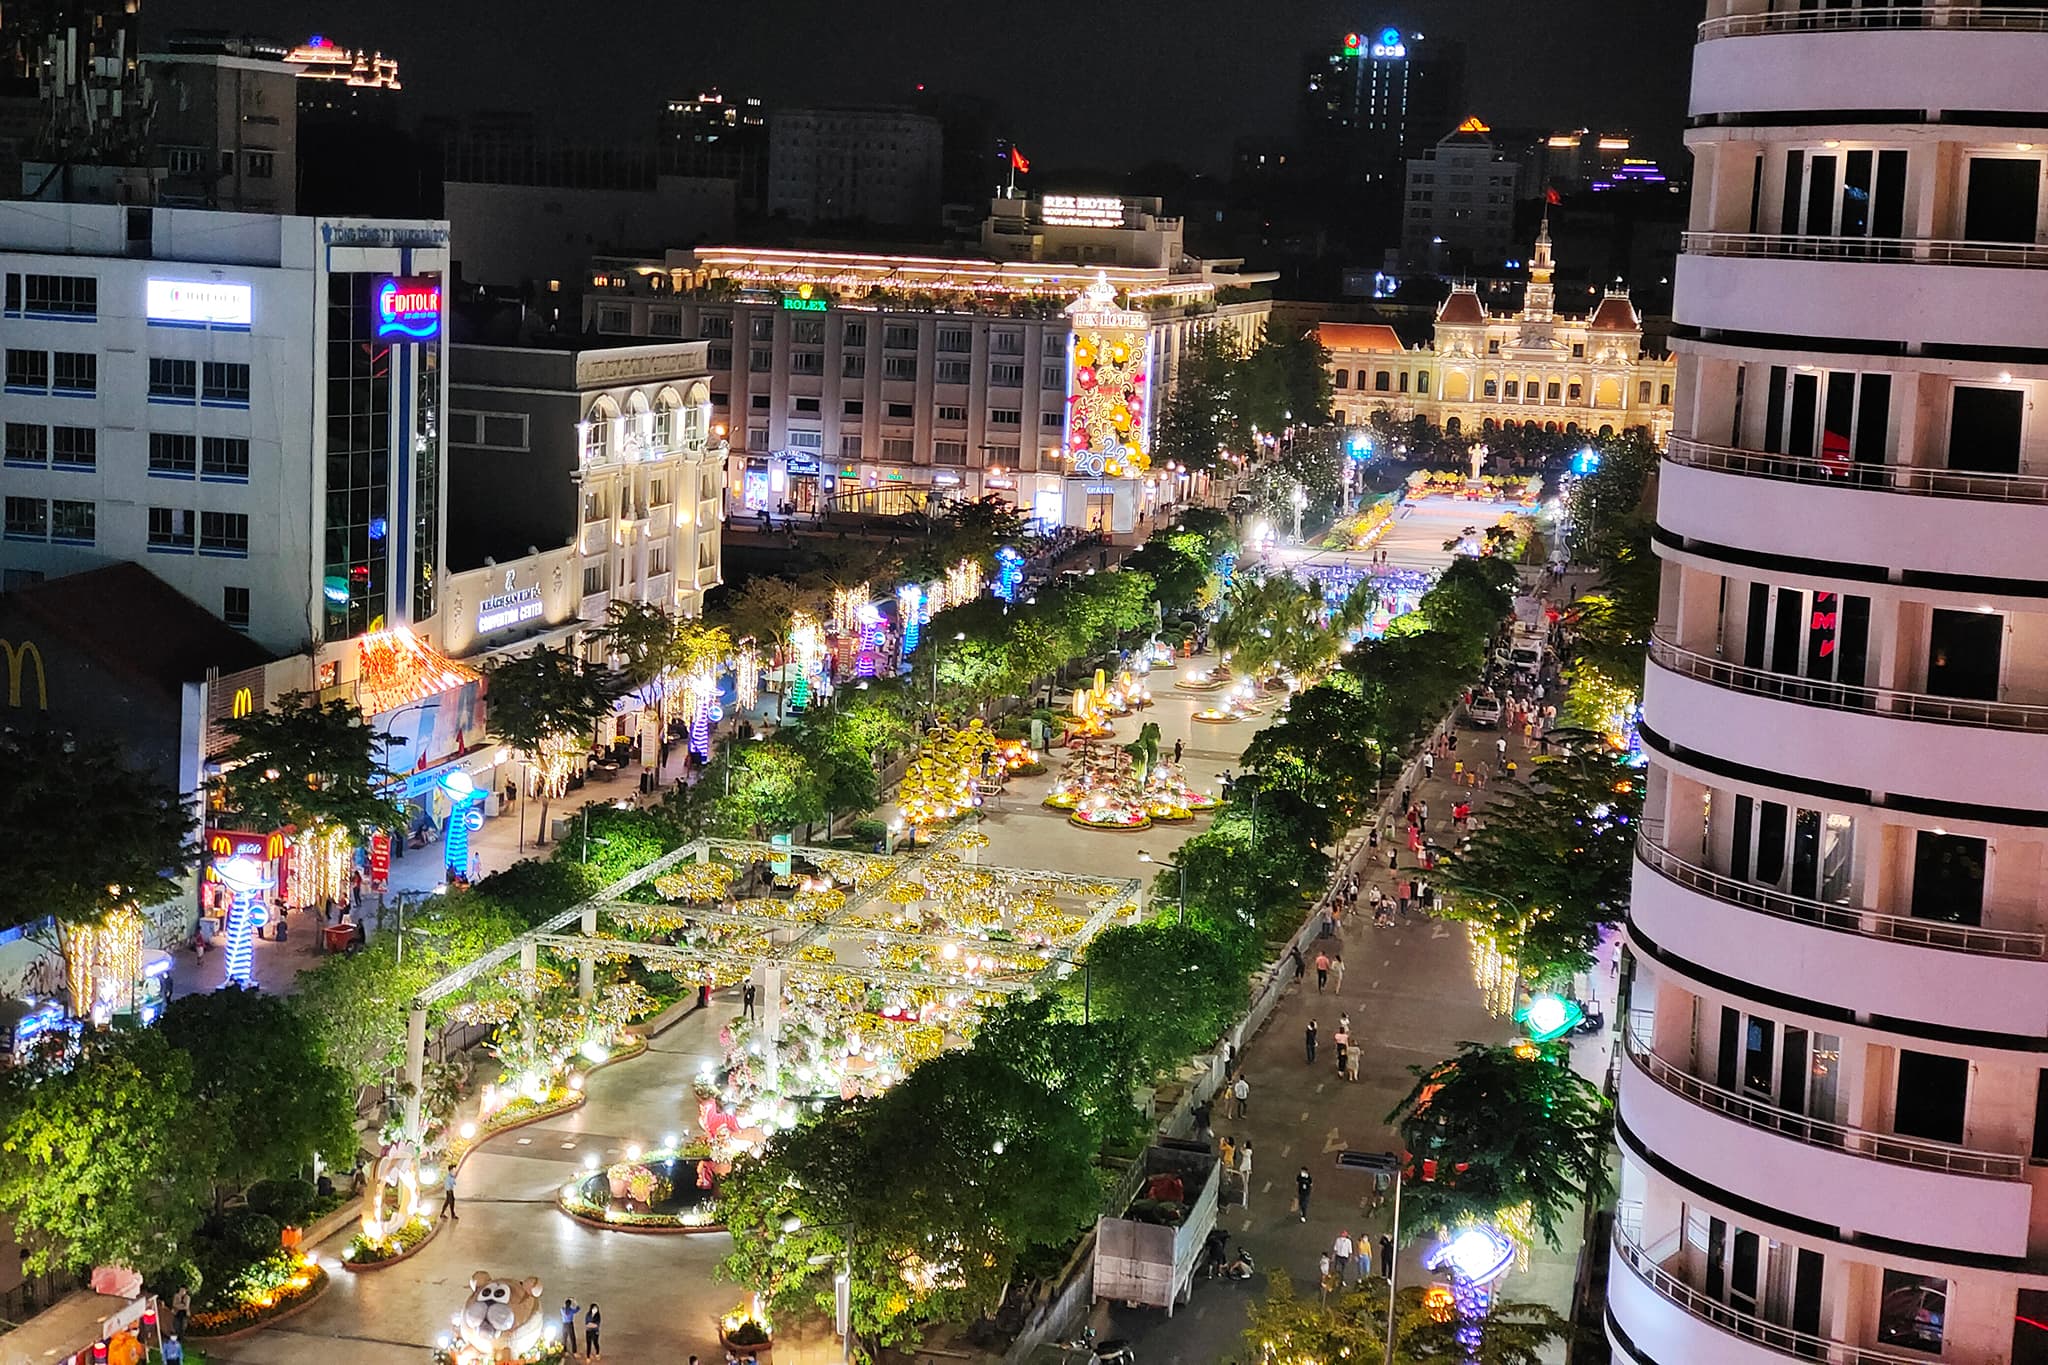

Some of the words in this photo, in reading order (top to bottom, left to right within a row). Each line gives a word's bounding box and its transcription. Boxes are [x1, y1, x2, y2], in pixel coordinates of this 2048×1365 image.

[1043, 196, 1076, 208] REX
[1077, 198, 1125, 210] HOTEL
[384, 291, 438, 314] FIDITOUR
[783, 299, 828, 311] ROLEX
[1076, 313, 1098, 327] REX
[1100, 314, 1149, 328] HOTEL
[520, 601, 543, 621] CENTER
